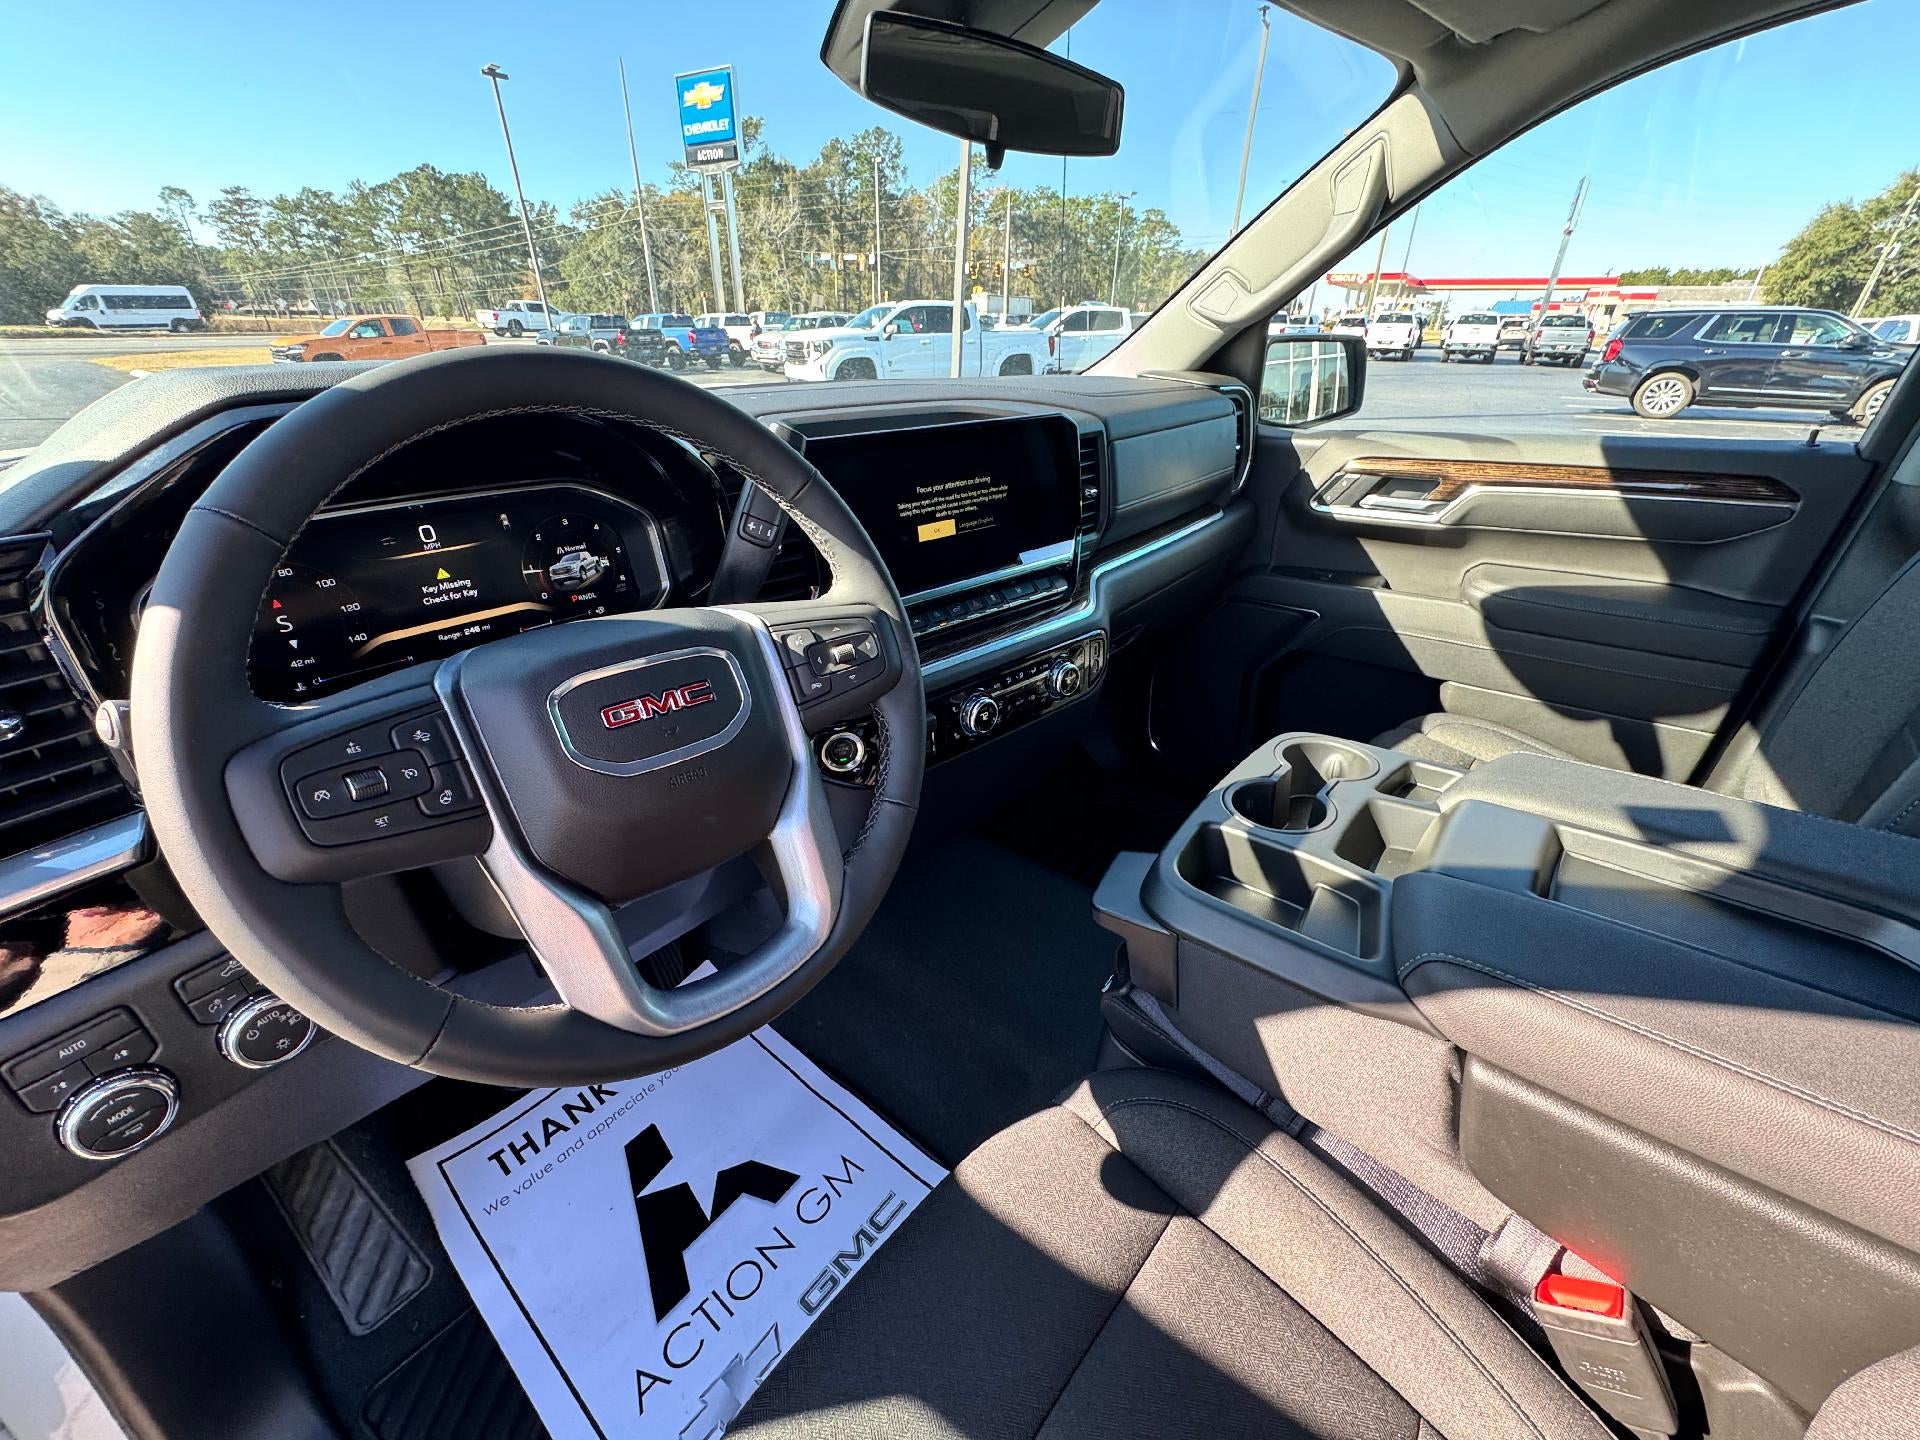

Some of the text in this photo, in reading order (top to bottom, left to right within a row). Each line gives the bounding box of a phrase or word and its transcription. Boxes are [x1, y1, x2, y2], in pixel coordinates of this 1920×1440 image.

[684, 118, 730, 136] CHEVROLET
[697, 148, 724, 160] ACTION
[418, 524, 436, 542] 0
[424, 542, 442, 550] MPH
[278, 568, 293, 577] 80
[316, 578, 336, 588] 100
[422, 579, 471, 594] Key Missing
[423, 589, 478, 605] Check for Key
[340, 603, 360, 613] 120
[276, 615, 293, 632] S
[348, 633, 368, 644] 140
[438, 630, 462, 642] Range:
[482, 623, 491, 631] mi
[290, 656, 316, 668] 42 mi
[600, 678, 716, 729] GMC
[346, 746, 362, 755] RES
[374, 816, 389, 826] SET
[256, 1010, 280, 1028] AUTO
[58, 1040, 87, 1060] AUTO
[106, 1104, 134, 1126] MODE
[487, 1084, 619, 1176] THANK
[482, 1194, 510, 1216] We
[513, 1162, 553, 1196] value
[556, 1137, 584, 1164] and
[587, 1084, 656, 1140] appreciate
[797, 1190, 908, 1317] GMC
[636, 1154, 866, 1417] ACTION GM
